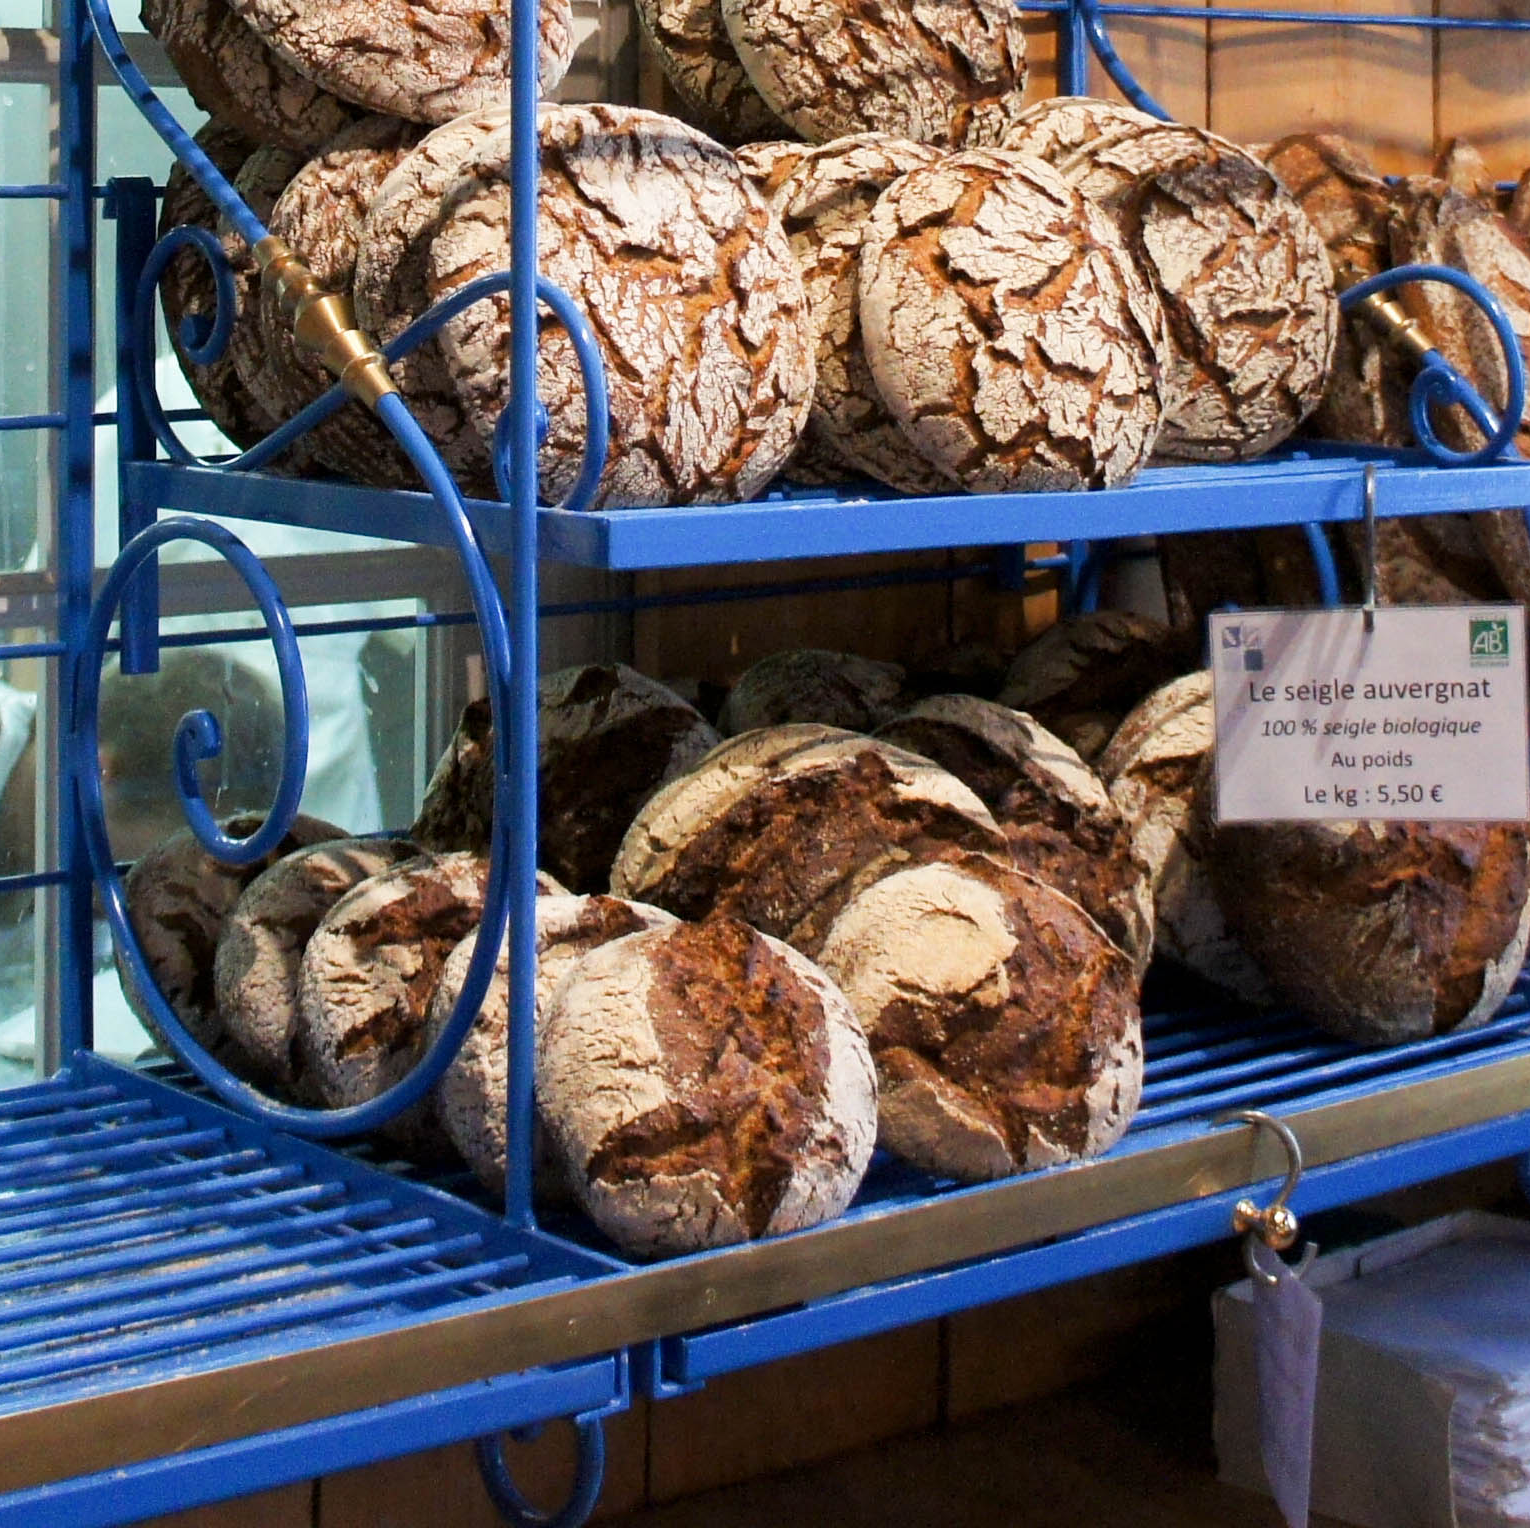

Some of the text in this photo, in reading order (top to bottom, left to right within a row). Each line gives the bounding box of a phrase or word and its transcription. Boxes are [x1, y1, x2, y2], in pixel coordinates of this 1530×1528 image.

[1249, 678, 1493, 706] Le seigle auvergnat
[1260, 717, 1483, 739] 100 % seigle biologique
[1330, 750, 1414, 771] Au poids
[1304, 784, 1328, 804] Le
[1333, 784, 1359, 808] kg
[1377, 784, 1424, 806] 5,50
[1430, 783, 1445, 803] €
